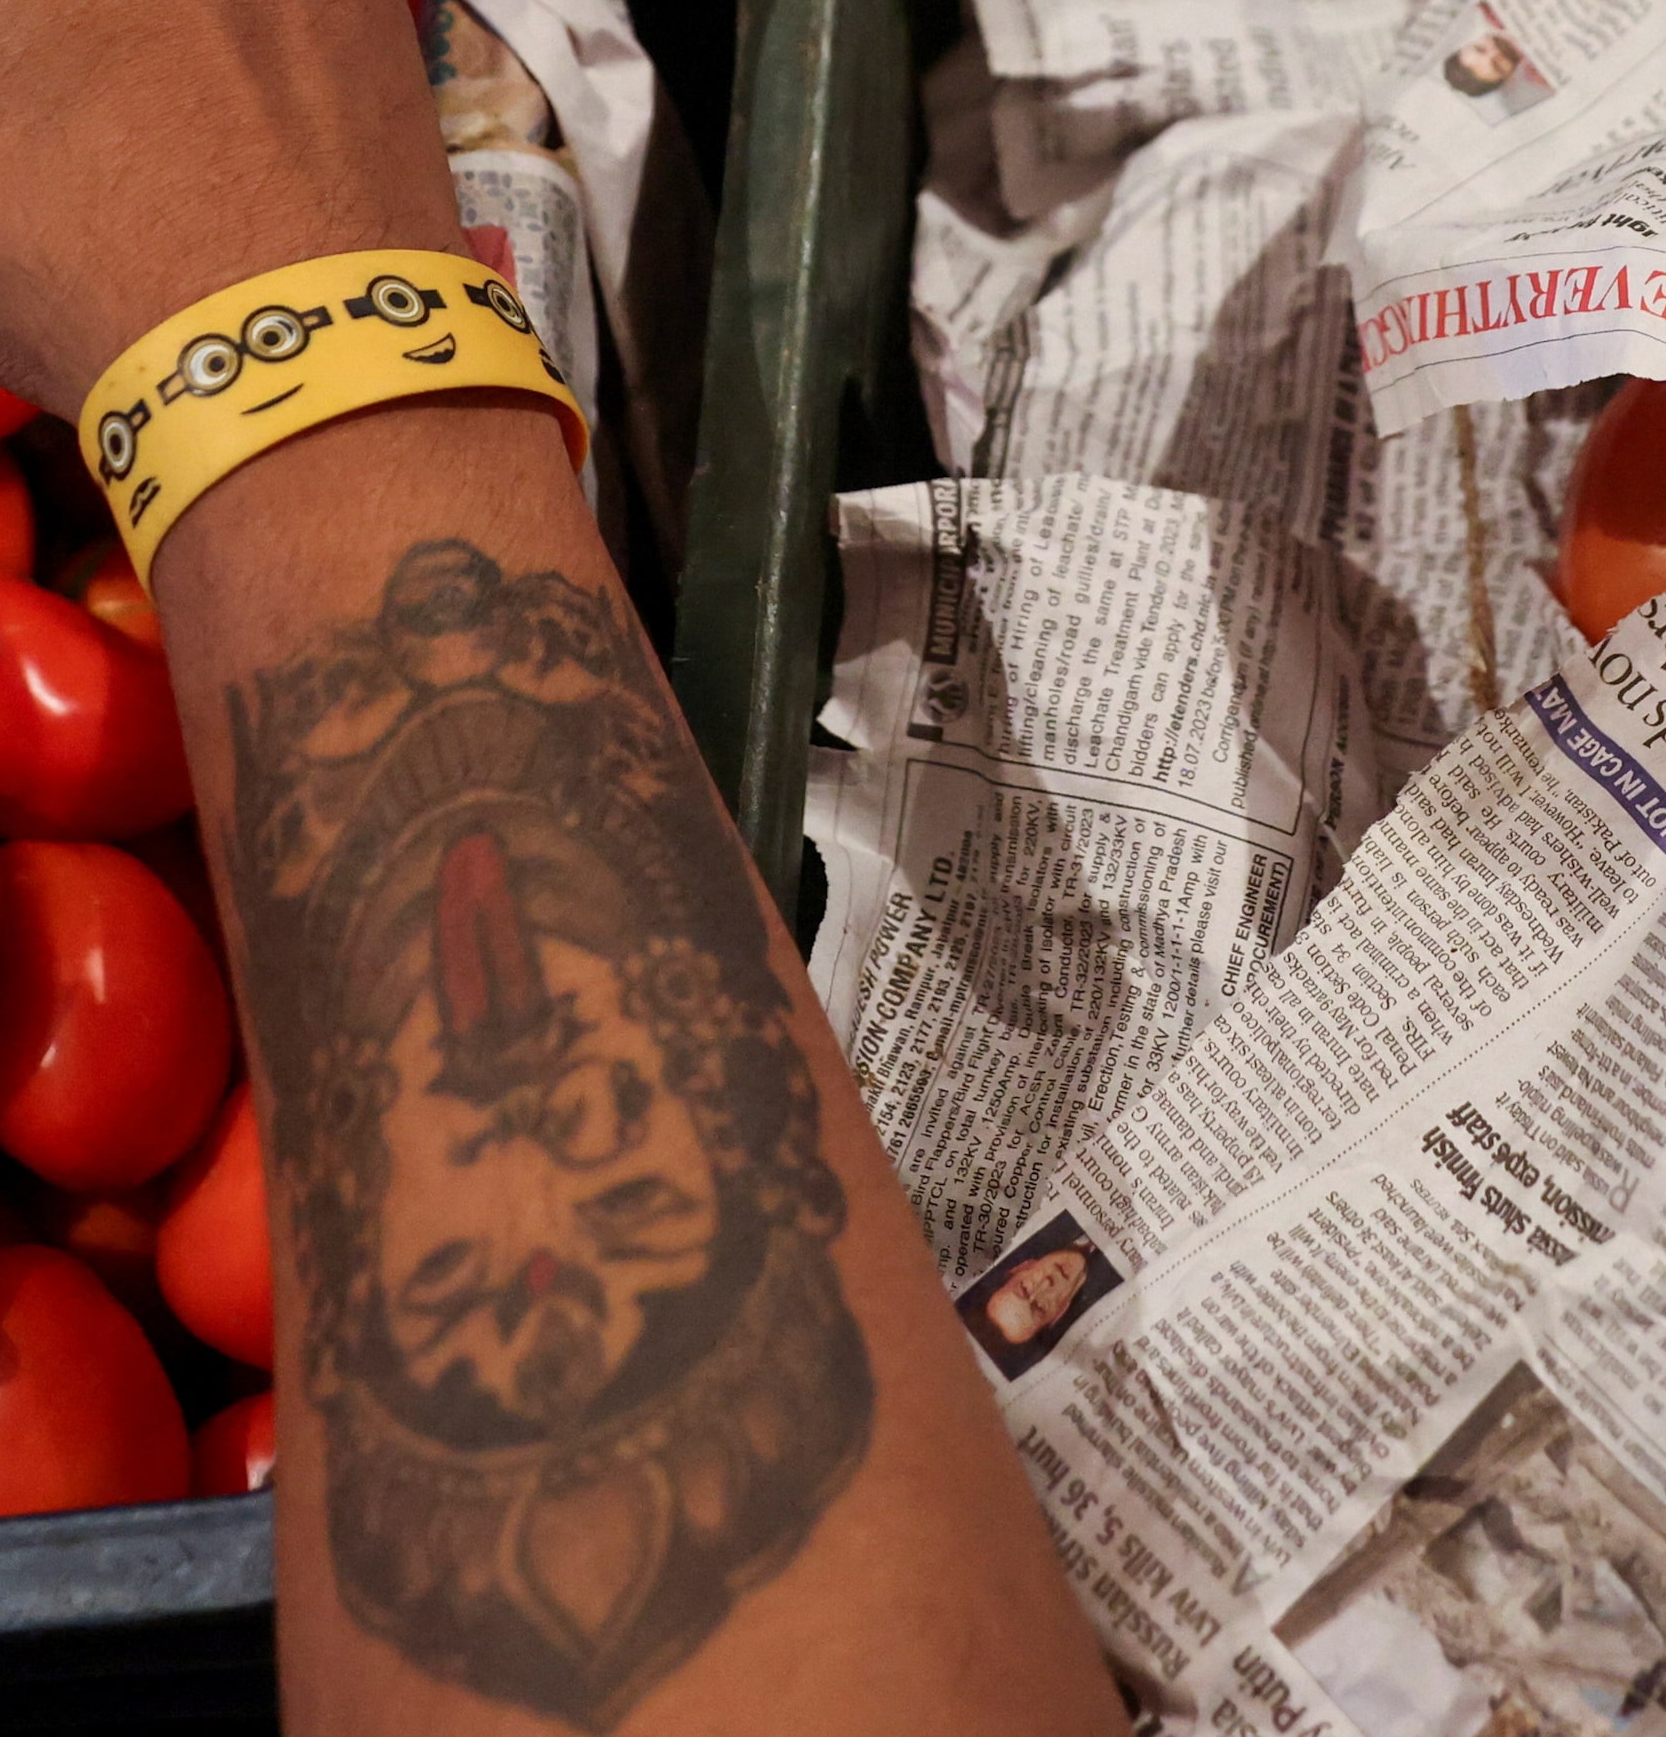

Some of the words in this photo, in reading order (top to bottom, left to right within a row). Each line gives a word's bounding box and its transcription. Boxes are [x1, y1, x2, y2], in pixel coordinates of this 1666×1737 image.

[1010, 589, 1040, 651] Hiring
[1043, 613, 1082, 762] manholes/road
[1083, 687, 1114, 769] Leachate
[1102, 591, 1140, 677] Treatment
[1063, 676, 1093, 765] discharge
[1105, 676, 1142, 772] Chandigarh
[1127, 713, 1159, 777] bidders
[1177, 699, 1213, 787] 18.07.2023
[1495, 752, 1524, 788] will
[1566, 727, 1623, 777] CAGE
[1404, 782, 1437, 817] said
[1428, 775, 1470, 827] before
[1447, 763, 1481, 800] said
[1468, 754, 1520, 813] advised
[1613, 769, 1647, 801] IN
[1062, 808, 1094, 899] TR-31/2023
[1087, 832, 1110, 884] supply
[1102, 814, 1128, 890] 132/33KV
[1158, 828, 1188, 893] Pradesh
[1429, 816, 1462, 852] had
[1465, 826, 1510, 865] appear
[1505, 828, 1547, 866] courts.
[1118, 841, 1142, 933] construction
[1346, 854, 1409, 922] intention
[1415, 866, 1451, 902] same
[1426, 844, 1456, 879] him
[1458, 847, 1500, 889] Imran
[1541, 831, 1620, 920] well-wishers
[1589, 846, 1627, 893] leave.
[1138, 845, 1164, 959] commissioning
[1406, 888, 1452, 931] person
[1518, 873, 1560, 918] ready
[1546, 872, 1605, 935] military
[1189, 901, 1213, 955] please
[1221, 942, 1245, 997] CHIEF
[1235, 853, 1268, 941] ENGINEER
[1403, 917, 1457, 971] common
[1499, 884, 1565, 965] Wednesday,
[1306, 942, 1351, 995] Section
[1355, 936, 1410, 989] criminal
[1387, 930, 1432, 975] people,
[1497, 956, 1530, 990] that
[1347, 991, 1380, 1028] Code
[1351, 962, 1398, 1011] Section
[1422, 973, 1475, 1032] several
[1477, 965, 1511, 1003] each
[1402, 1015, 1437, 1063] FIRs.
[1417, 999, 1453, 1046] when
[1374, 1025, 1418, 1077] Penal
[1445, 1100, 1502, 1151] staff
[1016, 1425, 1071, 1483] hurt
[1059, 1479, 1099, 1522] 36
[1095, 1504, 1124, 1547] 5,
[1118, 1533, 1174, 1600] kills
[1091, 1571, 1191, 1681] Russian
[1168, 1587, 1222, 1649] Lviv
[1232, 1644, 1308, 1734] Putin
